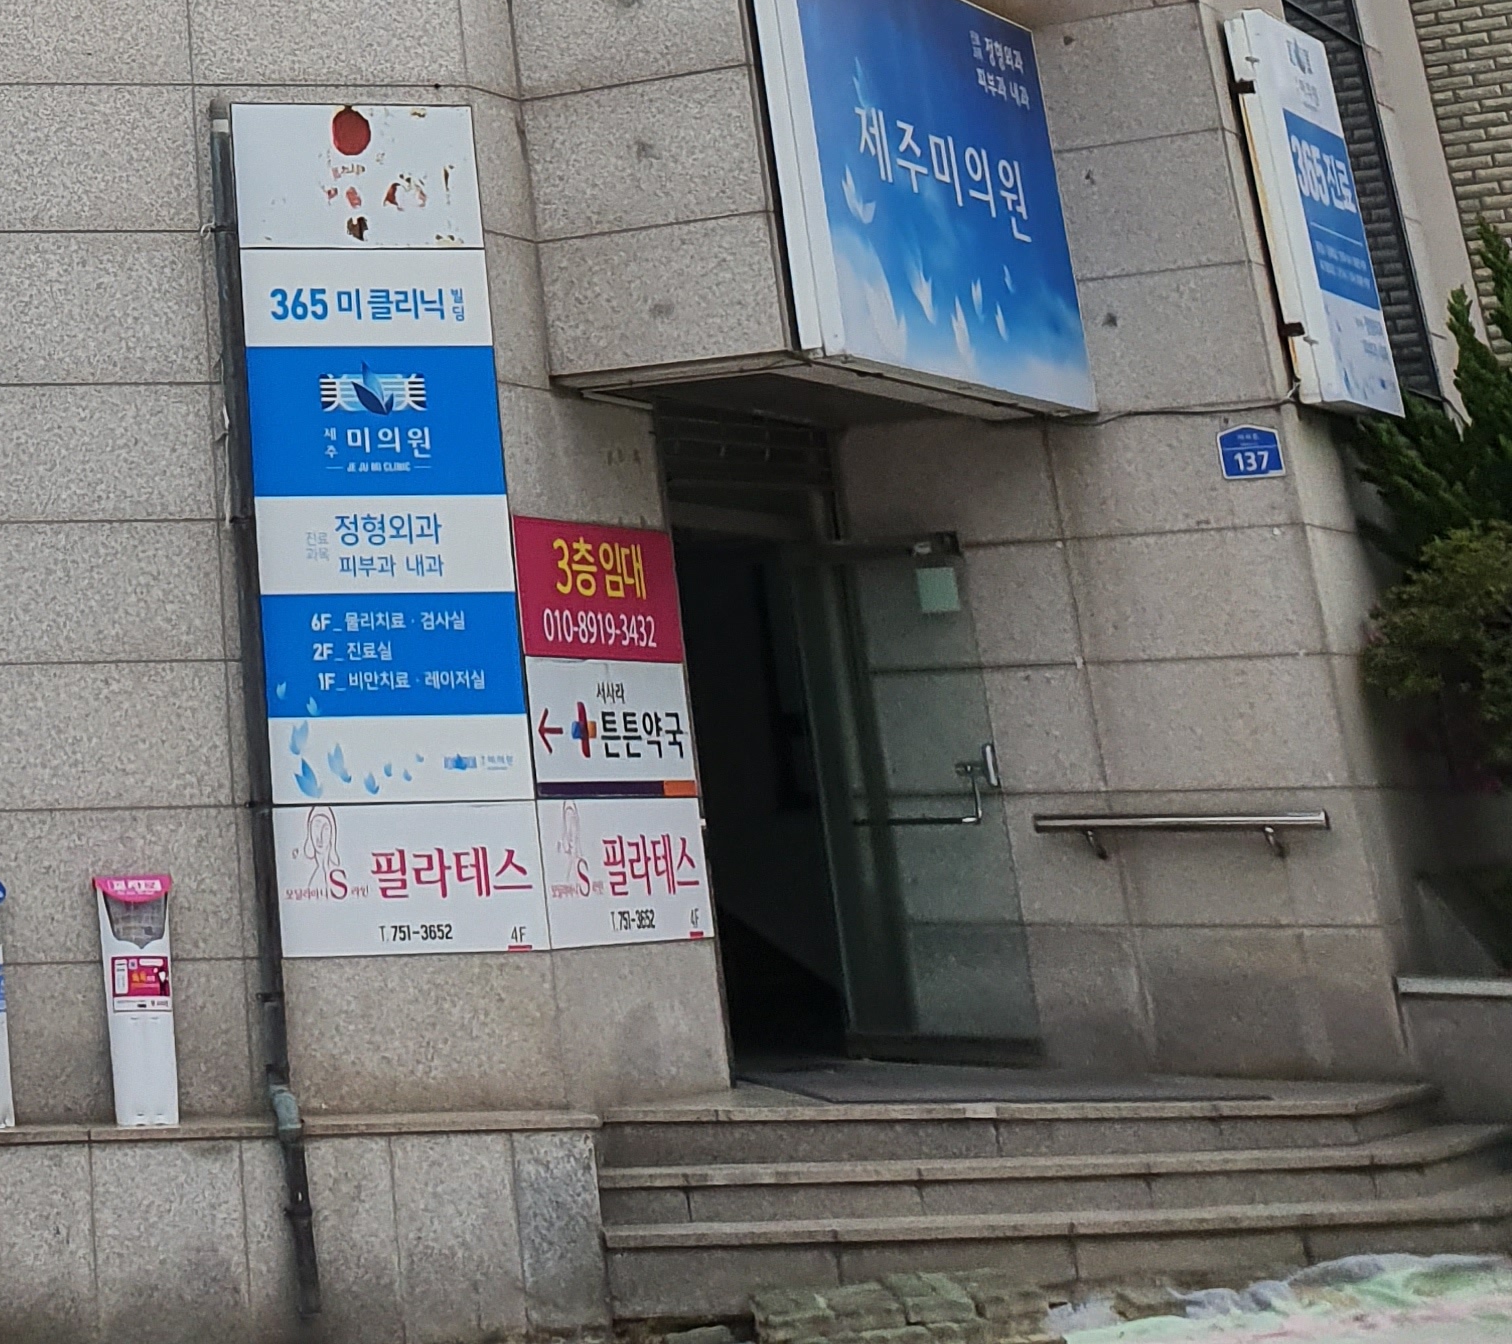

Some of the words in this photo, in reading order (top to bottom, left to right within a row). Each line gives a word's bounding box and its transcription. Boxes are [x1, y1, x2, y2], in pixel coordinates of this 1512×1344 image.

[984, 37, 1025, 75] 정형외과
[975, 67, 1008, 102] 피부과
[1009, 81, 1031, 111] 내과
[853, 103, 1032, 245] 제주미의원
[269, 288, 329, 322] 365
[346, 425, 432, 459] 미의원
[1233, 449, 1269, 472] 137
[333, 513, 442, 547] 정형외과
[338, 554, 396, 578] 피부과
[406, 552, 445, 578] 내과
[344, 610, 407, 631] 물리치료
[420, 610, 466, 631] 검사실
[542, 607, 658, 648] 010-8919-3432
[346, 642, 393, 662] 진료실
[348, 670, 411, 691] 비만치료
[423, 669, 486, 691] 레이저실
[596, 681, 626, 704] 서사라
[600, 711, 684, 759] 튼튼약국
[370, 845, 534, 900] 필라테스
[602, 833, 700, 897] 필라테스
[378, 923, 454, 942] T.751-3652
[510, 924, 528, 944] 4F
